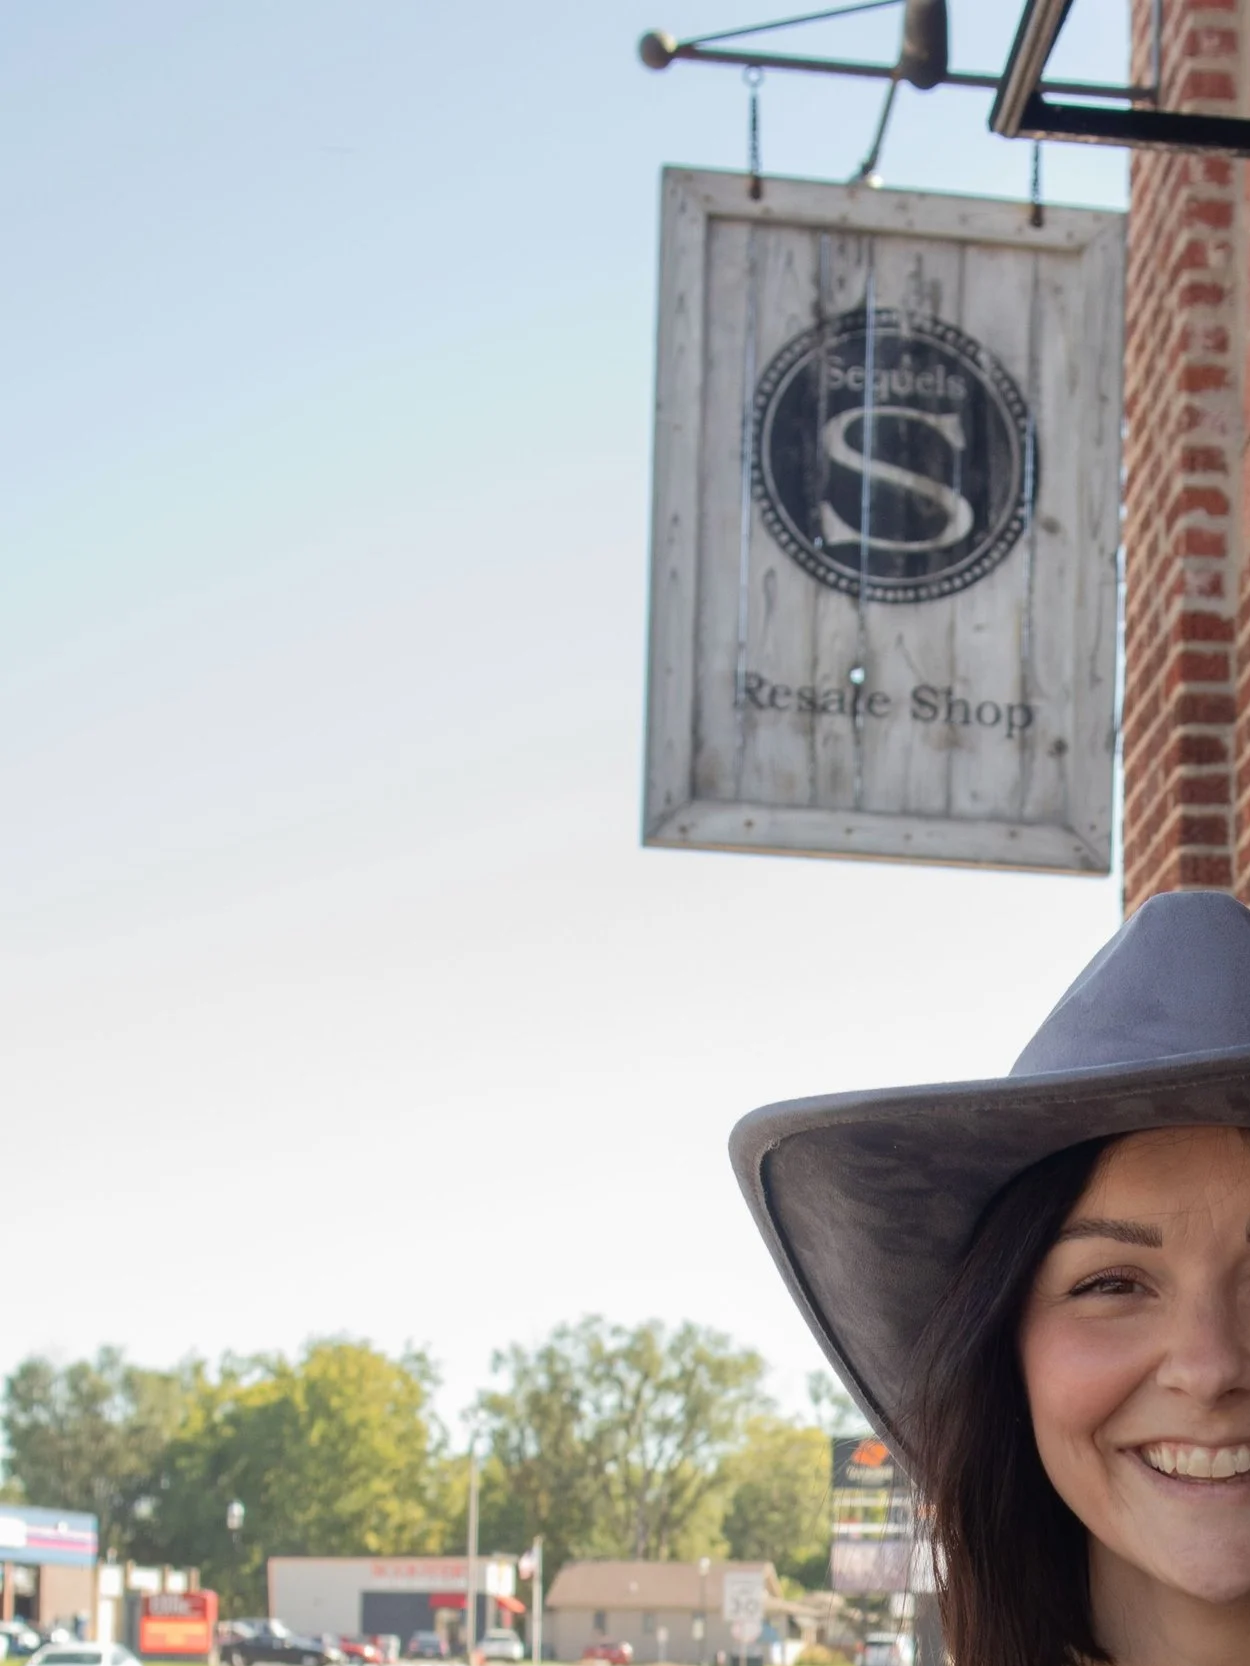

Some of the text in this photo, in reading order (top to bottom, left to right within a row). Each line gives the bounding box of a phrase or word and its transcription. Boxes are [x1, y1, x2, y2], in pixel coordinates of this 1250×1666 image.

[820, 405, 974, 552] S
[734, 671, 1034, 738] Resale Shop
